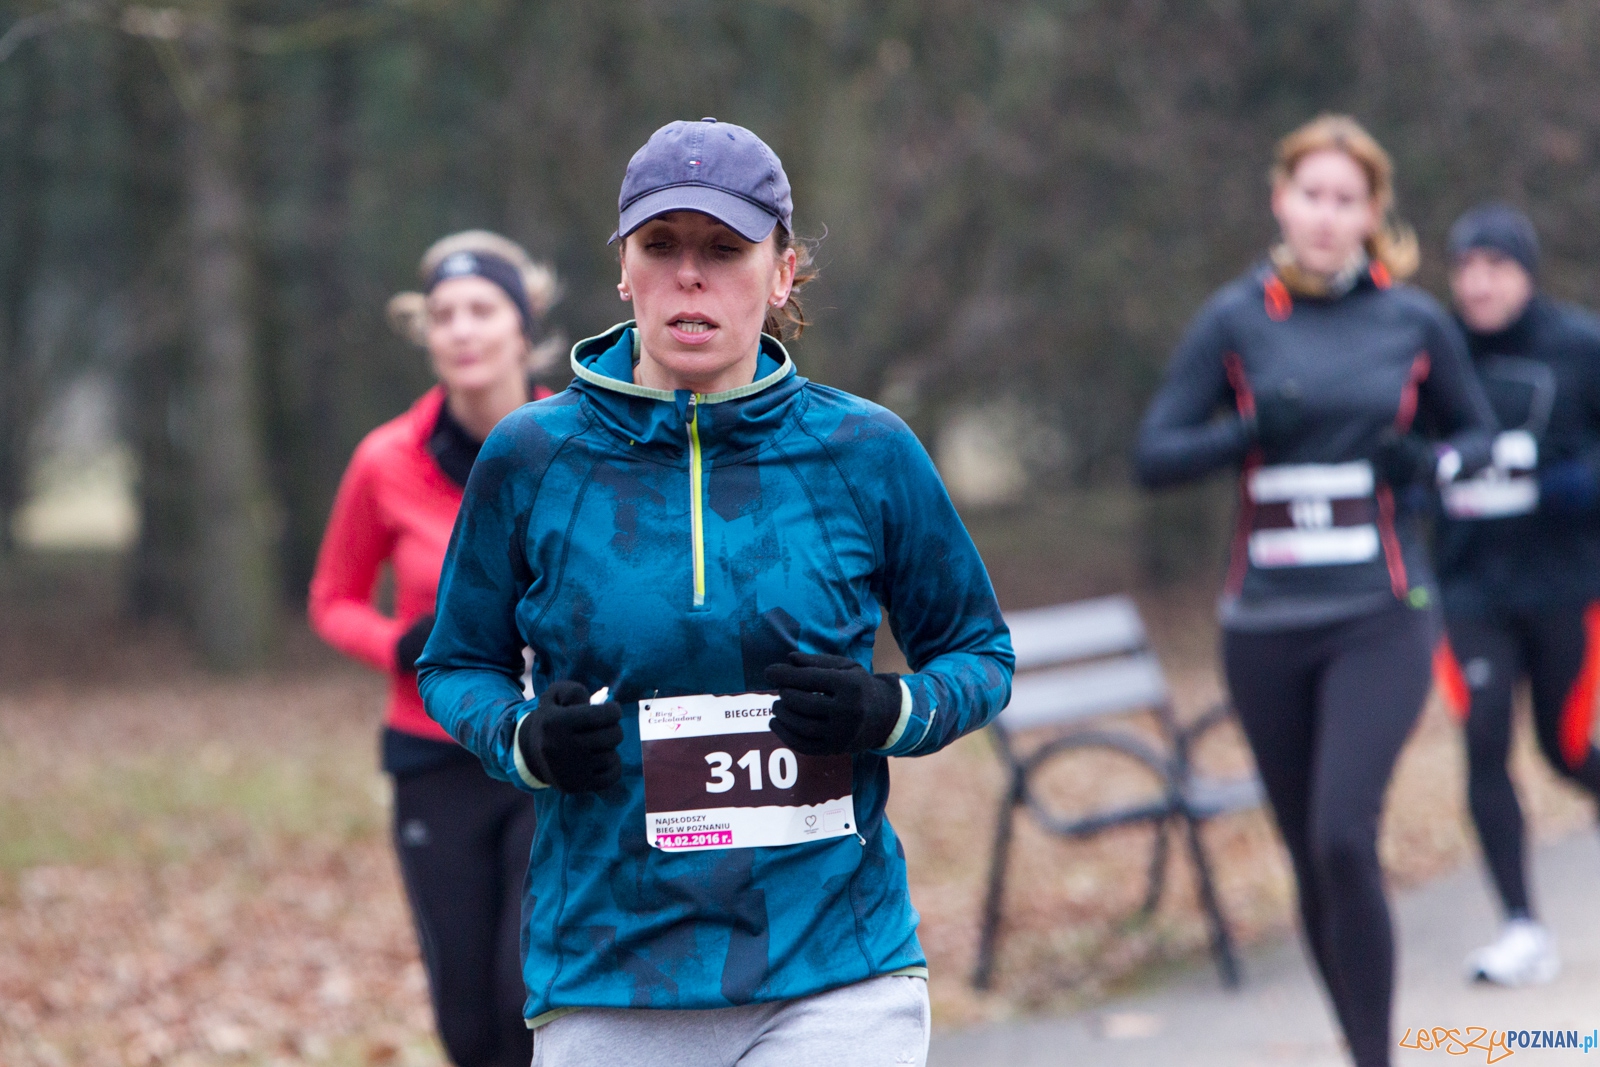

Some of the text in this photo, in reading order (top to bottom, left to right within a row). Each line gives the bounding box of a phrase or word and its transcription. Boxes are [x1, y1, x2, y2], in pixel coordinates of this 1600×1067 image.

[704, 747, 798, 793] 310
[655, 815, 706, 826] NAJSŁODSZY
[656, 826, 675, 834] BIEG
[686, 823, 731, 832] POZNANIU
[657, 833, 732, 848] 14.02.2016 r.
